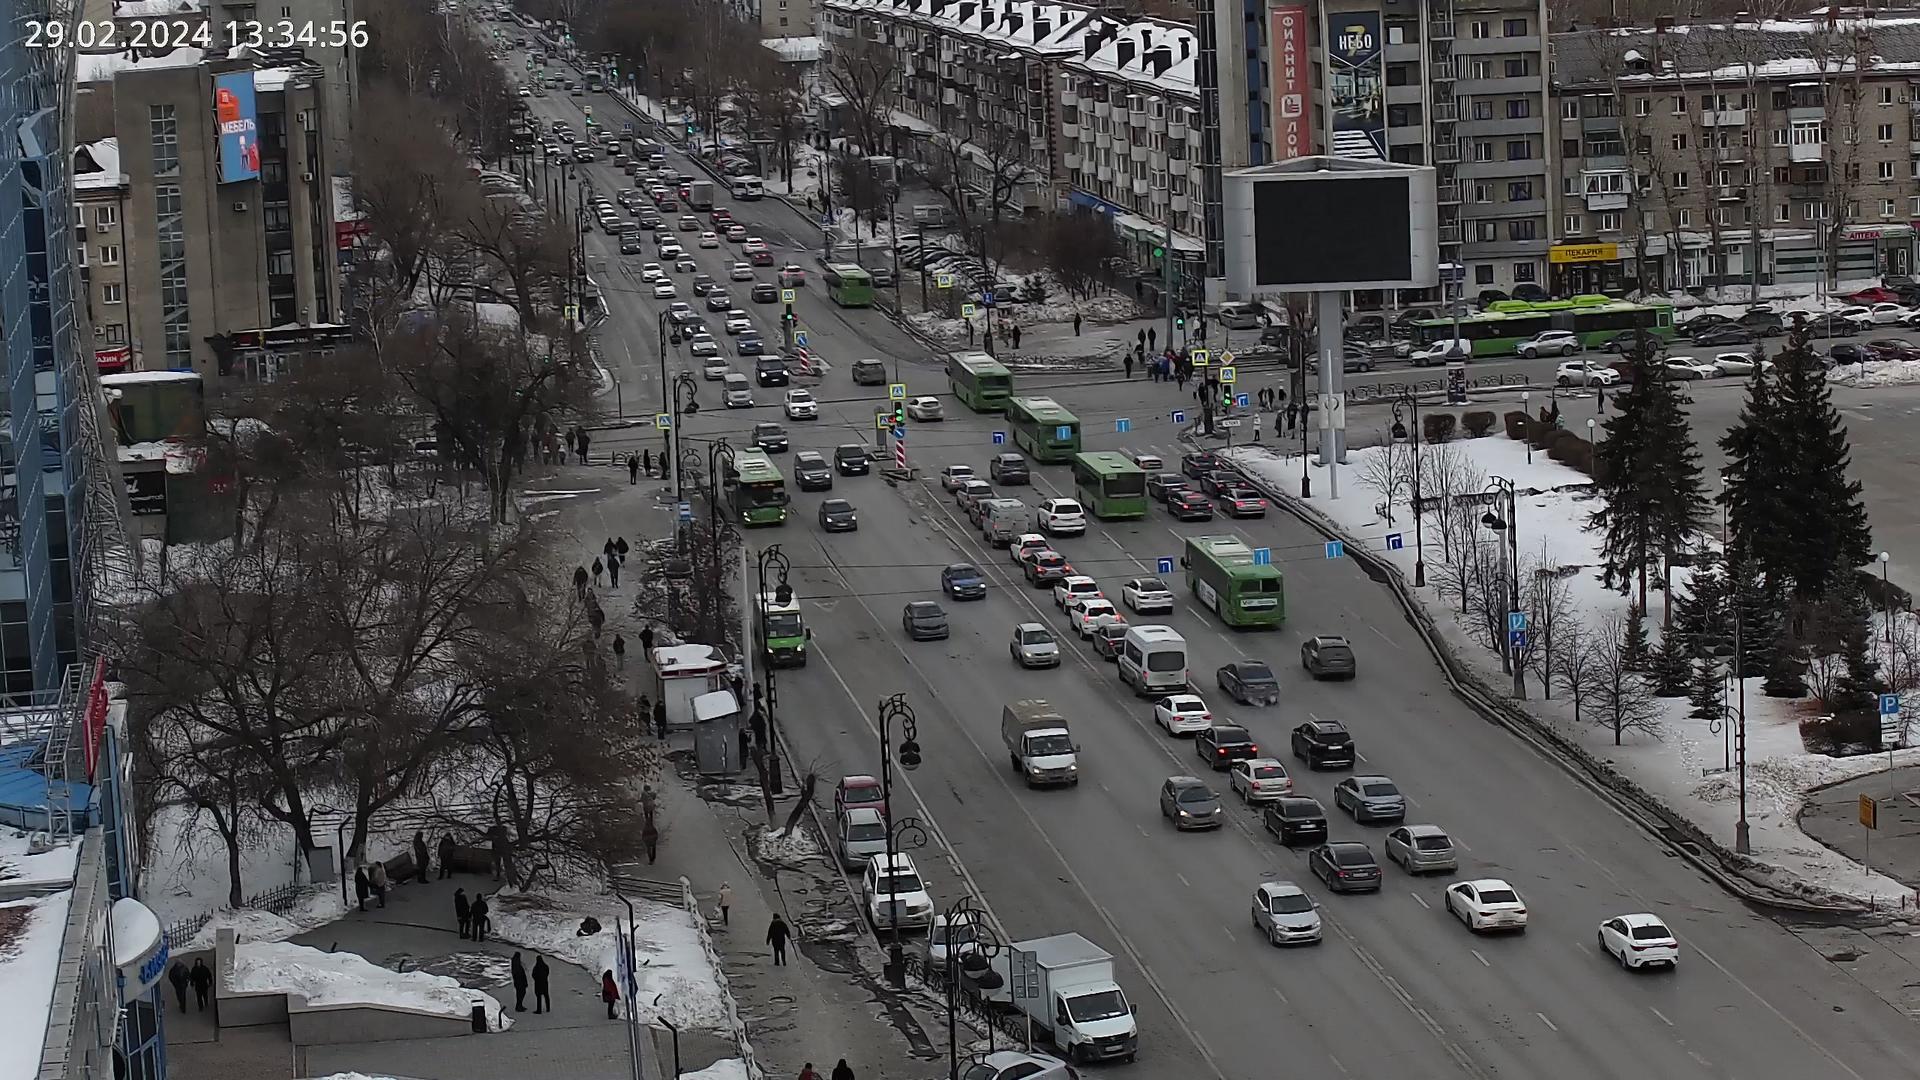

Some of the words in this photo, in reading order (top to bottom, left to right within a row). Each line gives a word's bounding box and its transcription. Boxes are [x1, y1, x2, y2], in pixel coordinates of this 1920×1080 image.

[1339, 34, 1373, 51] НЕБО
[1282, 16, 1297, 91] ФИАНИТ
[221, 119, 256, 135] МЕБЕЛЬ
[1849, 232, 1880, 240] АПТЕКА
[1565, 248, 1603, 257] ПЕКАРНЯ
[1885, 697, 1896, 712] P
